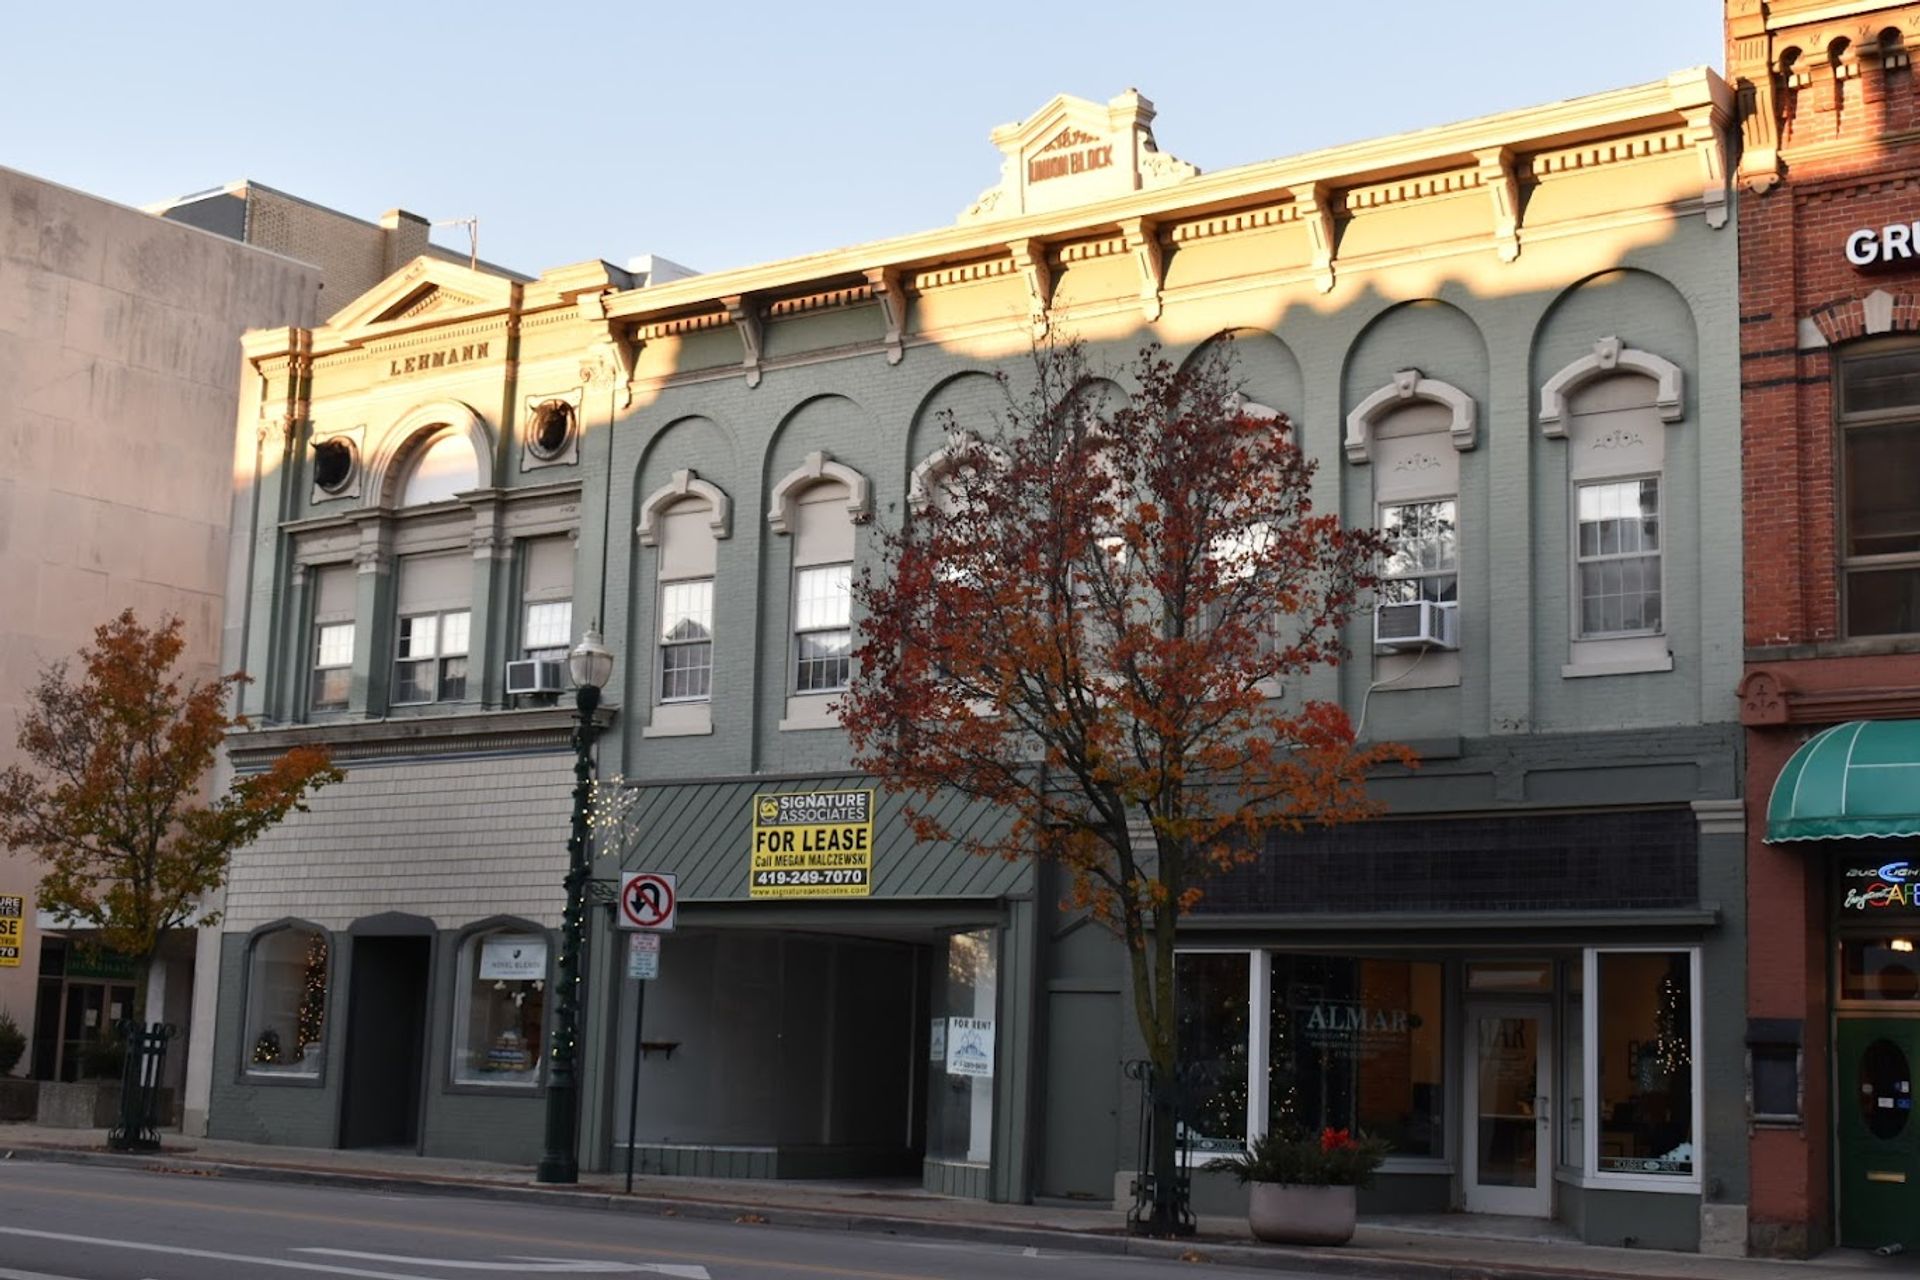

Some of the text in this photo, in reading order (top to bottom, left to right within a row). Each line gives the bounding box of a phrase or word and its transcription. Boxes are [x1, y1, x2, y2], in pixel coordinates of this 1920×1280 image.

[1070, 144, 1112, 174] BLOCK
[390, 342, 489, 376] LEHMANN
[780, 793, 866, 809] SIGNATURE
[779, 807, 865, 822] ASSOCIATES
[756, 828, 867, 853] FOR LEASE
[755, 853, 866, 867] Call MEGAN MALCZEWSKI
[758, 870, 862, 884] 419-249-7070
[954, 1019, 970, 1028] FOR
[972, 1019, 991, 1030] RENT
[1307, 1005, 1409, 1033] ALMAR
